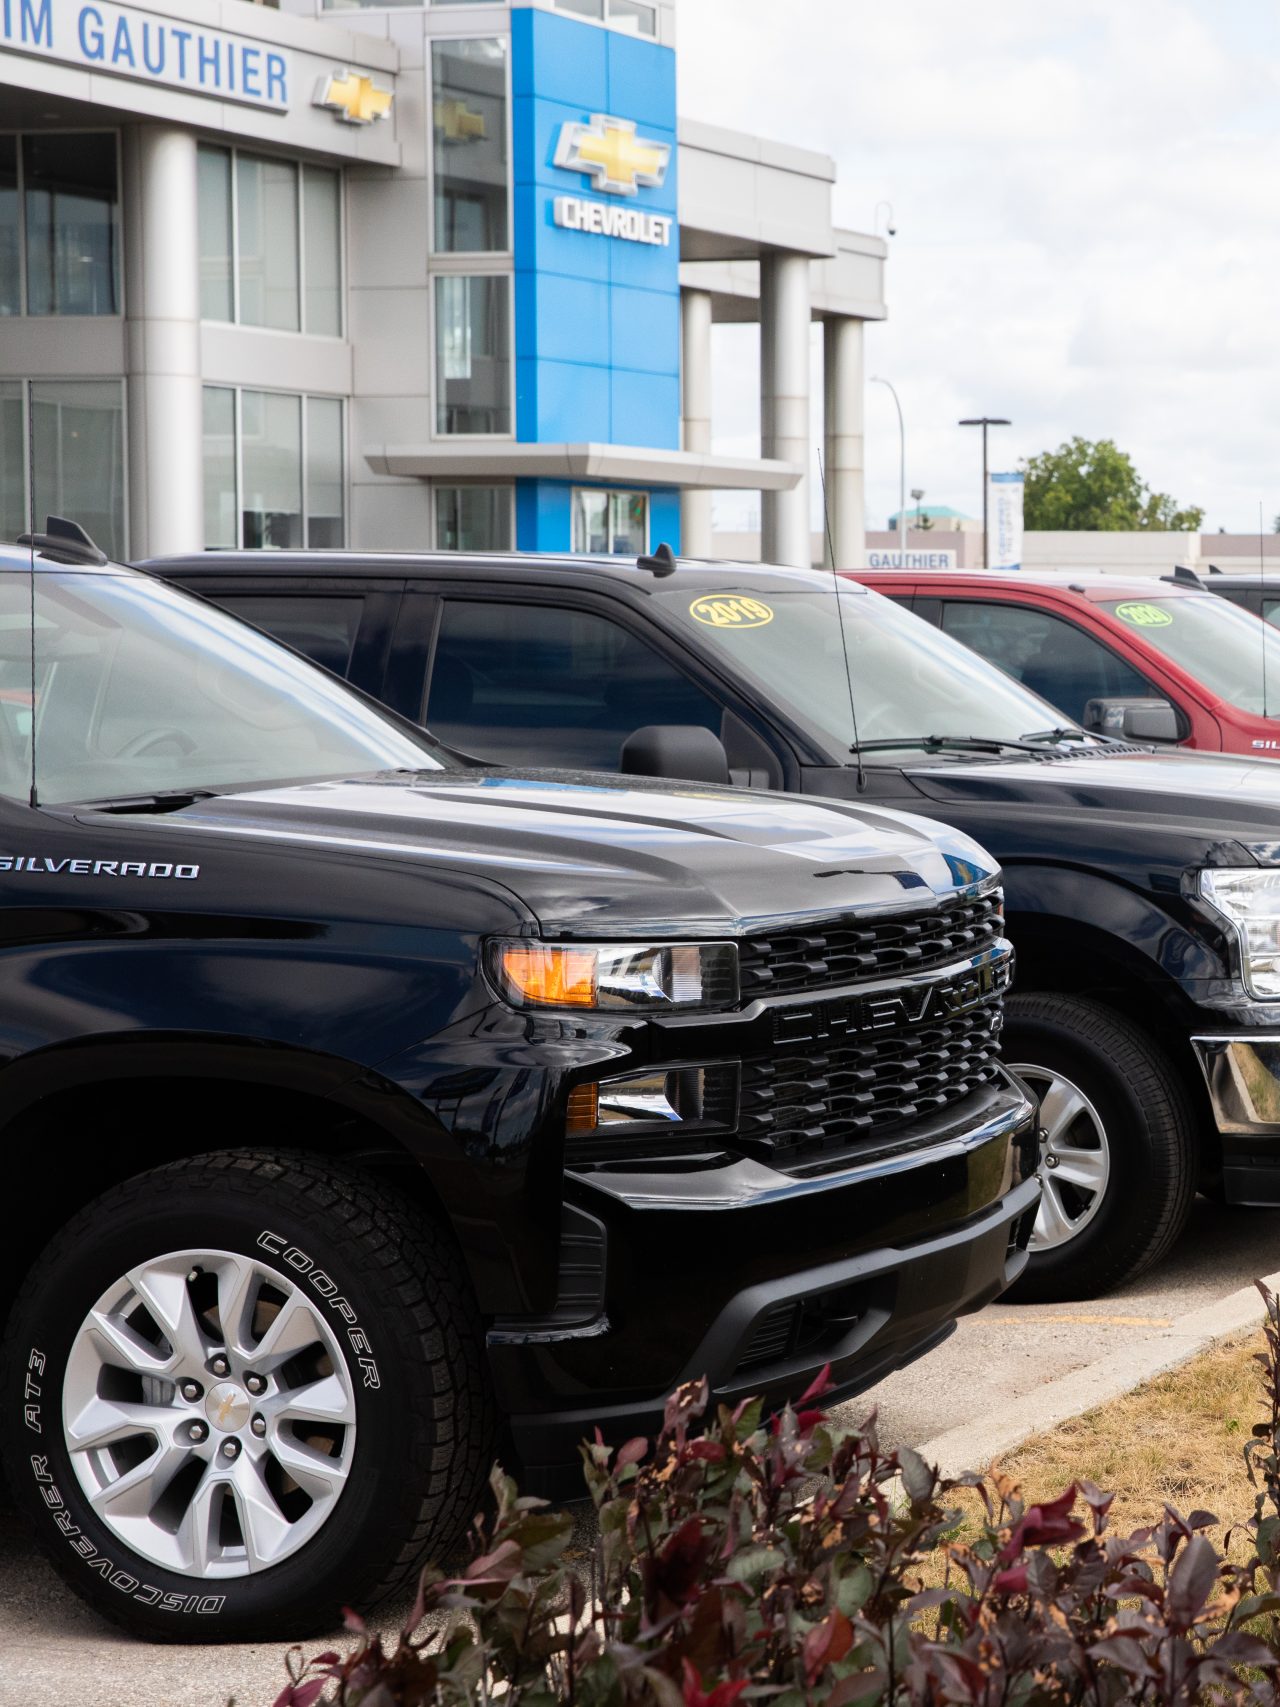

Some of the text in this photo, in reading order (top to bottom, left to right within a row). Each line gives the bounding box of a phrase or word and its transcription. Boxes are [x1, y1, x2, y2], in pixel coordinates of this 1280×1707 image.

[78, 6, 288, 104] GAUTHIER
[557, 196, 672, 247] CHEVROLET
[868, 553, 949, 568] GAUTHIER
[697, 600, 769, 625] 2019
[0, 856, 200, 879] SILVERADO
[256, 1230, 381, 1390] COOPER
[25, 1348, 226, 1614] DISCOVERER AT3
